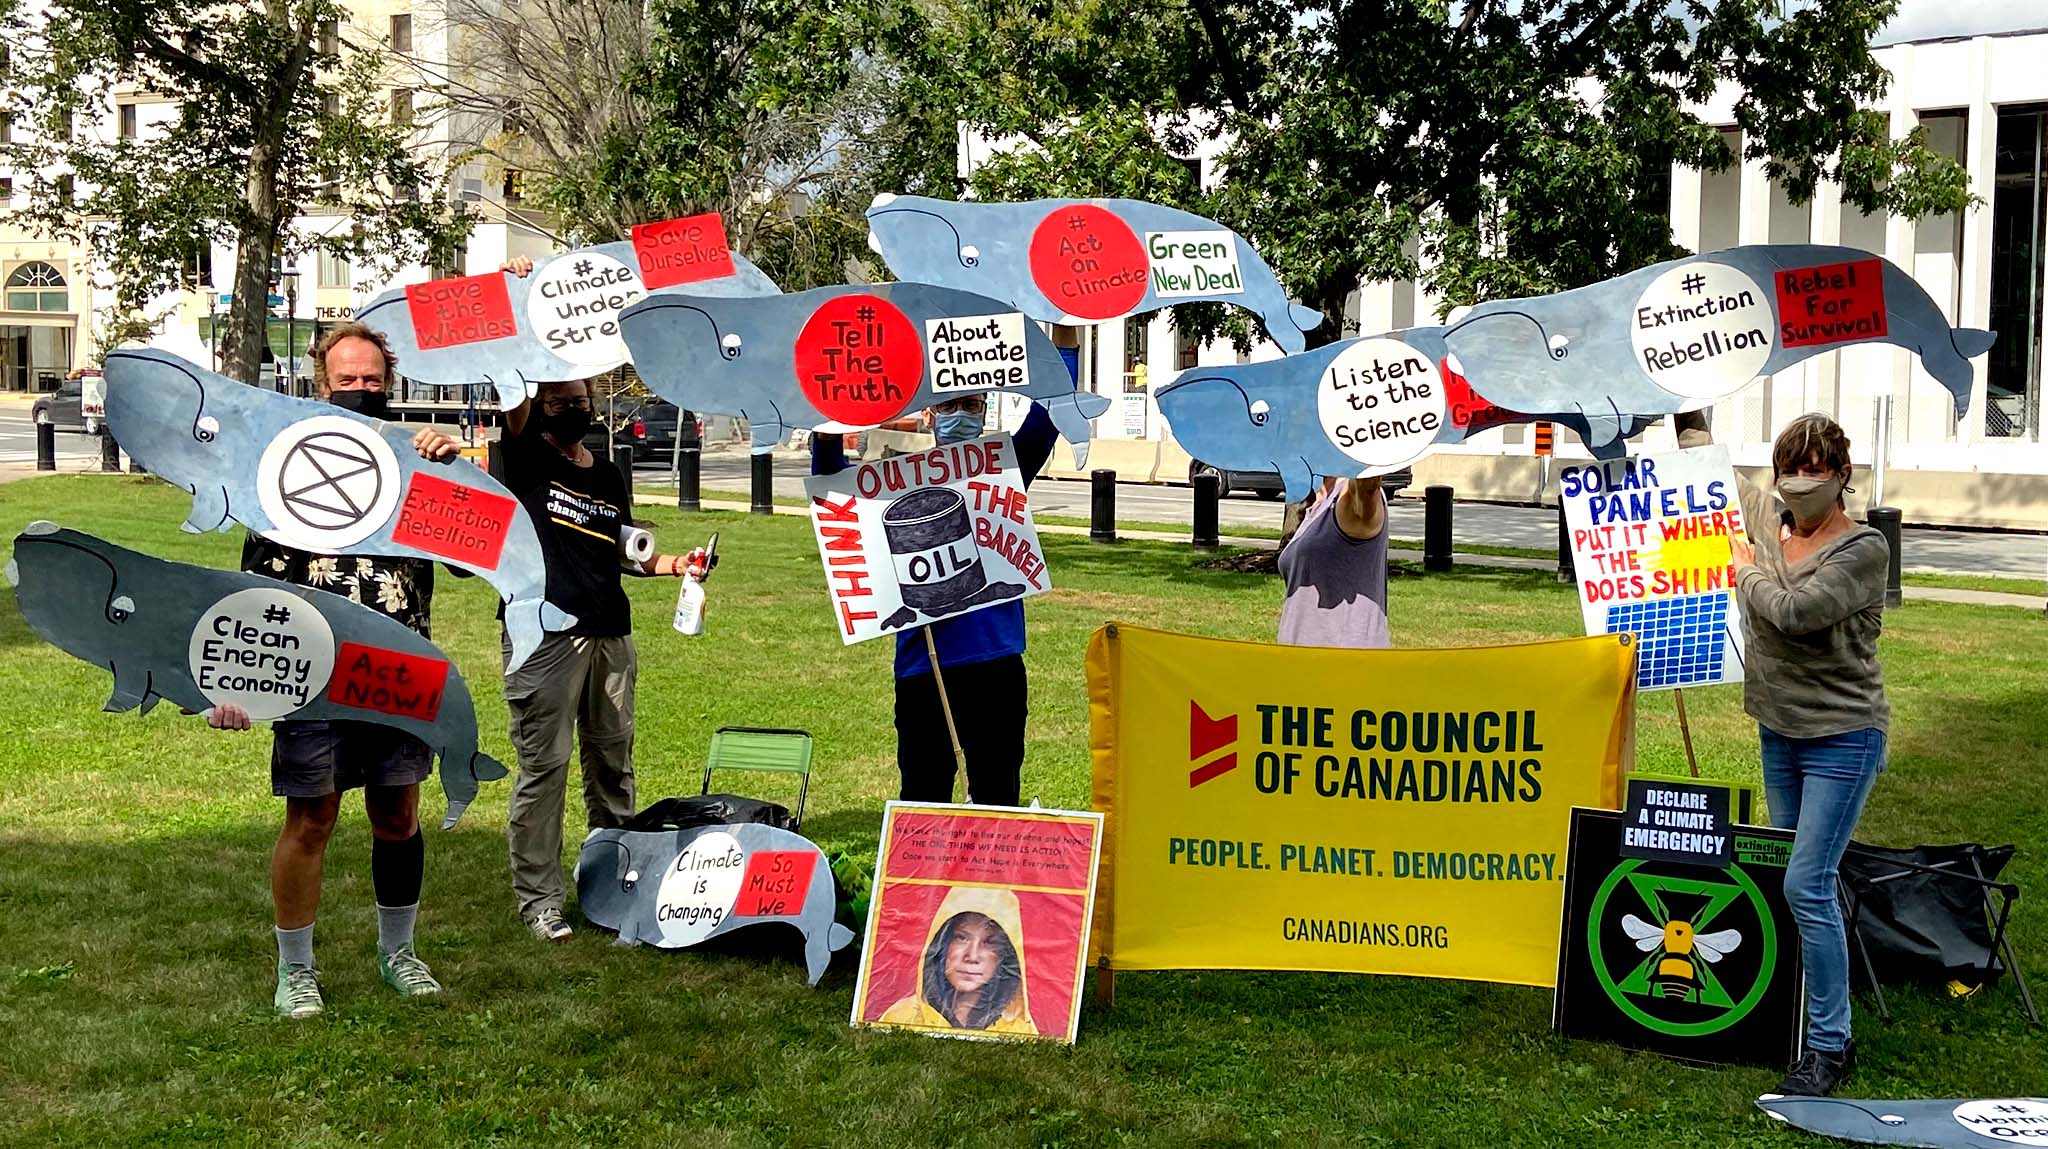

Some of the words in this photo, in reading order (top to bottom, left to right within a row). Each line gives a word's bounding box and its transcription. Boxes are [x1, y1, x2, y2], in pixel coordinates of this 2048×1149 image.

[640, 223, 704, 249] Save
[1059, 234, 1103, 257] Act
[1150, 233, 1227, 259] Green
[639, 244, 730, 273] Ourselves
[540, 264, 633, 300] Climate
[1061, 268, 1146, 298] Climate
[1152, 266, 1191, 292] New
[1195, 264, 1241, 291] Deal
[1784, 265, 1856, 296] Rebel
[413, 281, 482, 305] Save
[1807, 298, 1855, 317] For
[315, 307, 336, 318] THE
[436, 299, 486, 319] the
[1637, 289, 1754, 330] Extinction
[416, 319, 513, 348] Whales
[546, 320, 618, 350] Stre
[831, 321, 883, 348] Tell
[932, 319, 1001, 344] About
[1781, 312, 1881, 342] Survival
[822, 348, 883, 374] The
[934, 341, 1025, 365] Climate
[1643, 327, 1768, 373] Rebellion
[814, 374, 904, 401] Truth
[936, 366, 1023, 388] Change
[1331, 358, 1427, 390] Listen
[1347, 391, 1378, 411] to
[1385, 380, 1432, 404] the
[1335, 411, 1440, 448] Science
[857, 441, 1003, 499] OUTSIDE
[1560, 458, 1660, 498] SOLAR
[404, 488, 502, 533] Extinction
[546, 501, 590, 525] change
[549, 488, 598, 515] running
[599, 505, 617, 519] for
[967, 481, 1028, 525] THE
[1588, 480, 1728, 525] PANELS
[400, 510, 489, 551] Rebellion
[1574, 526, 1616, 552] PUT
[1623, 524, 1648, 547] IT
[1658, 510, 1744, 542] WHERE
[813, 494, 878, 635] THINK
[909, 545, 972, 583] OIL
[975, 517, 1045, 591] BARREL
[1591, 550, 1641, 575] THE
[1584, 575, 1645, 603] DOES
[1652, 565, 1738, 595] SHINE
[213, 615, 300, 650] Clean
[202, 639, 311, 682] Energy
[351, 653, 414, 686] Act
[199, 667, 309, 707] Economy
[1256, 704, 1334, 748] THE
[1350, 709, 1544, 754] COUNCIL
[1255, 751, 1302, 796] OF
[1314, 755, 1543, 803] CANADIANS
[1646, 789, 1708, 810] DECLARE
[1638, 808, 1649, 824] A
[1654, 809, 1714, 831] CLIMATE
[949, 841, 975, 850] THING
[1624, 827, 1726, 855] EMERGENCY
[1736, 840, 1787, 854] extinction
[677, 844, 743, 872] Climate
[771, 854, 792, 873] So
[1169, 837, 1271, 870] PEOPLE.
[1281, 844, 1384, 877] PLANET.
[1393, 851, 1565, 882] DEMOCRACY.
[693, 875, 707, 894] is
[750, 873, 795, 894] Must
[658, 902, 723, 927] Changing
[757, 898, 785, 916] We
[1283, 917, 1449, 949] CANADIANS.ORG
[1958, 1114, 2048, 1125] Warmi
[1990, 1127, 2048, 1138] Oce
